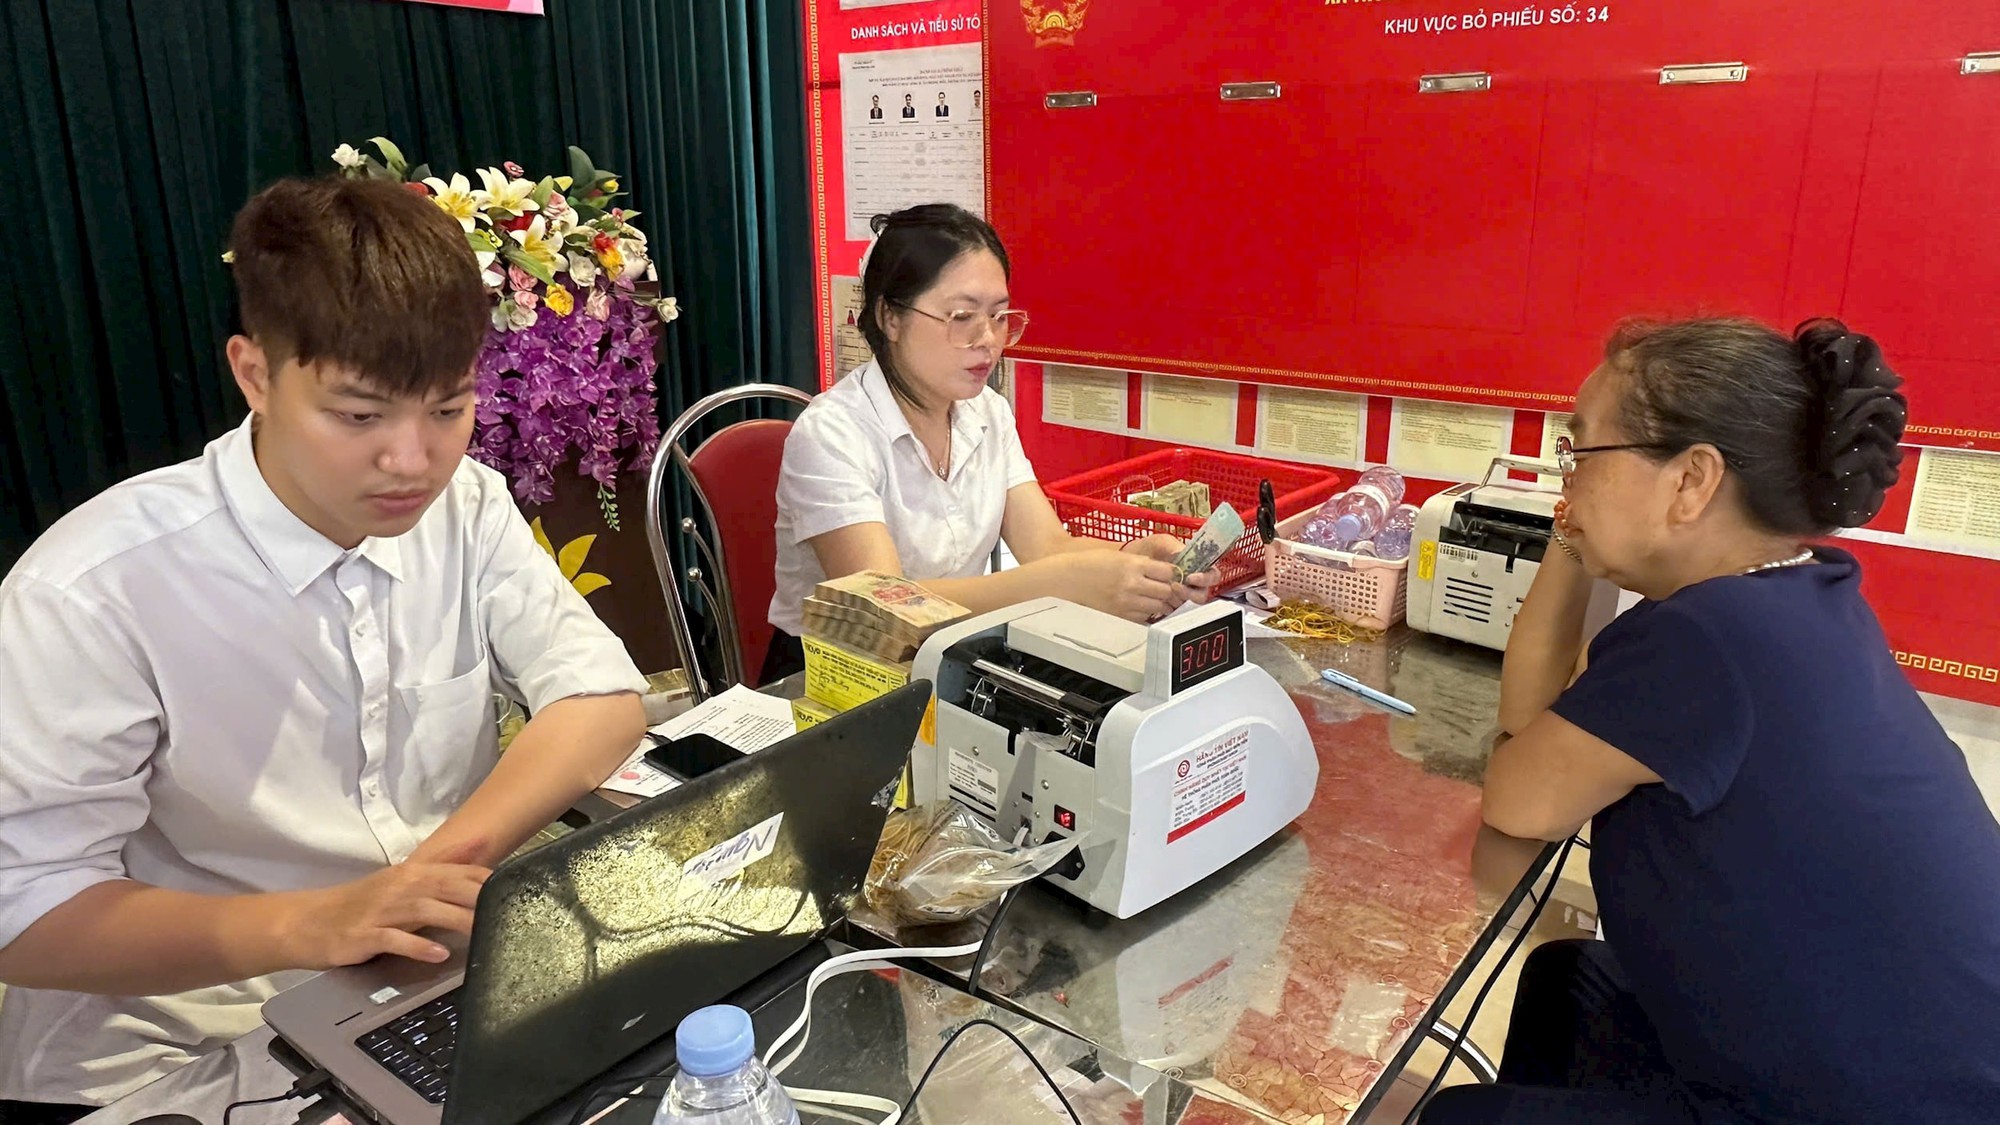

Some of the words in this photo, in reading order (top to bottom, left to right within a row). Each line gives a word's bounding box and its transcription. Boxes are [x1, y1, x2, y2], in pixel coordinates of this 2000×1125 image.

[852, 27, 878, 39] DANH
[881, 21, 908, 36] SÁCH
[911, 19, 926, 34] VÀ
[929, 14, 948, 32] TIỂU
[951, 14, 964, 31] SỬ
[1385, 19, 1417, 33] KHU
[1423, 16, 1457, 34] VỰC
[1462, 9, 1486, 29] BỎ
[1492, 5, 1543, 27] PHIẾU
[1550, 2, 1580, 23] SỐ:
[1587, 6, 1609, 23] 34
[1182, 634, 1224, 674] 300
